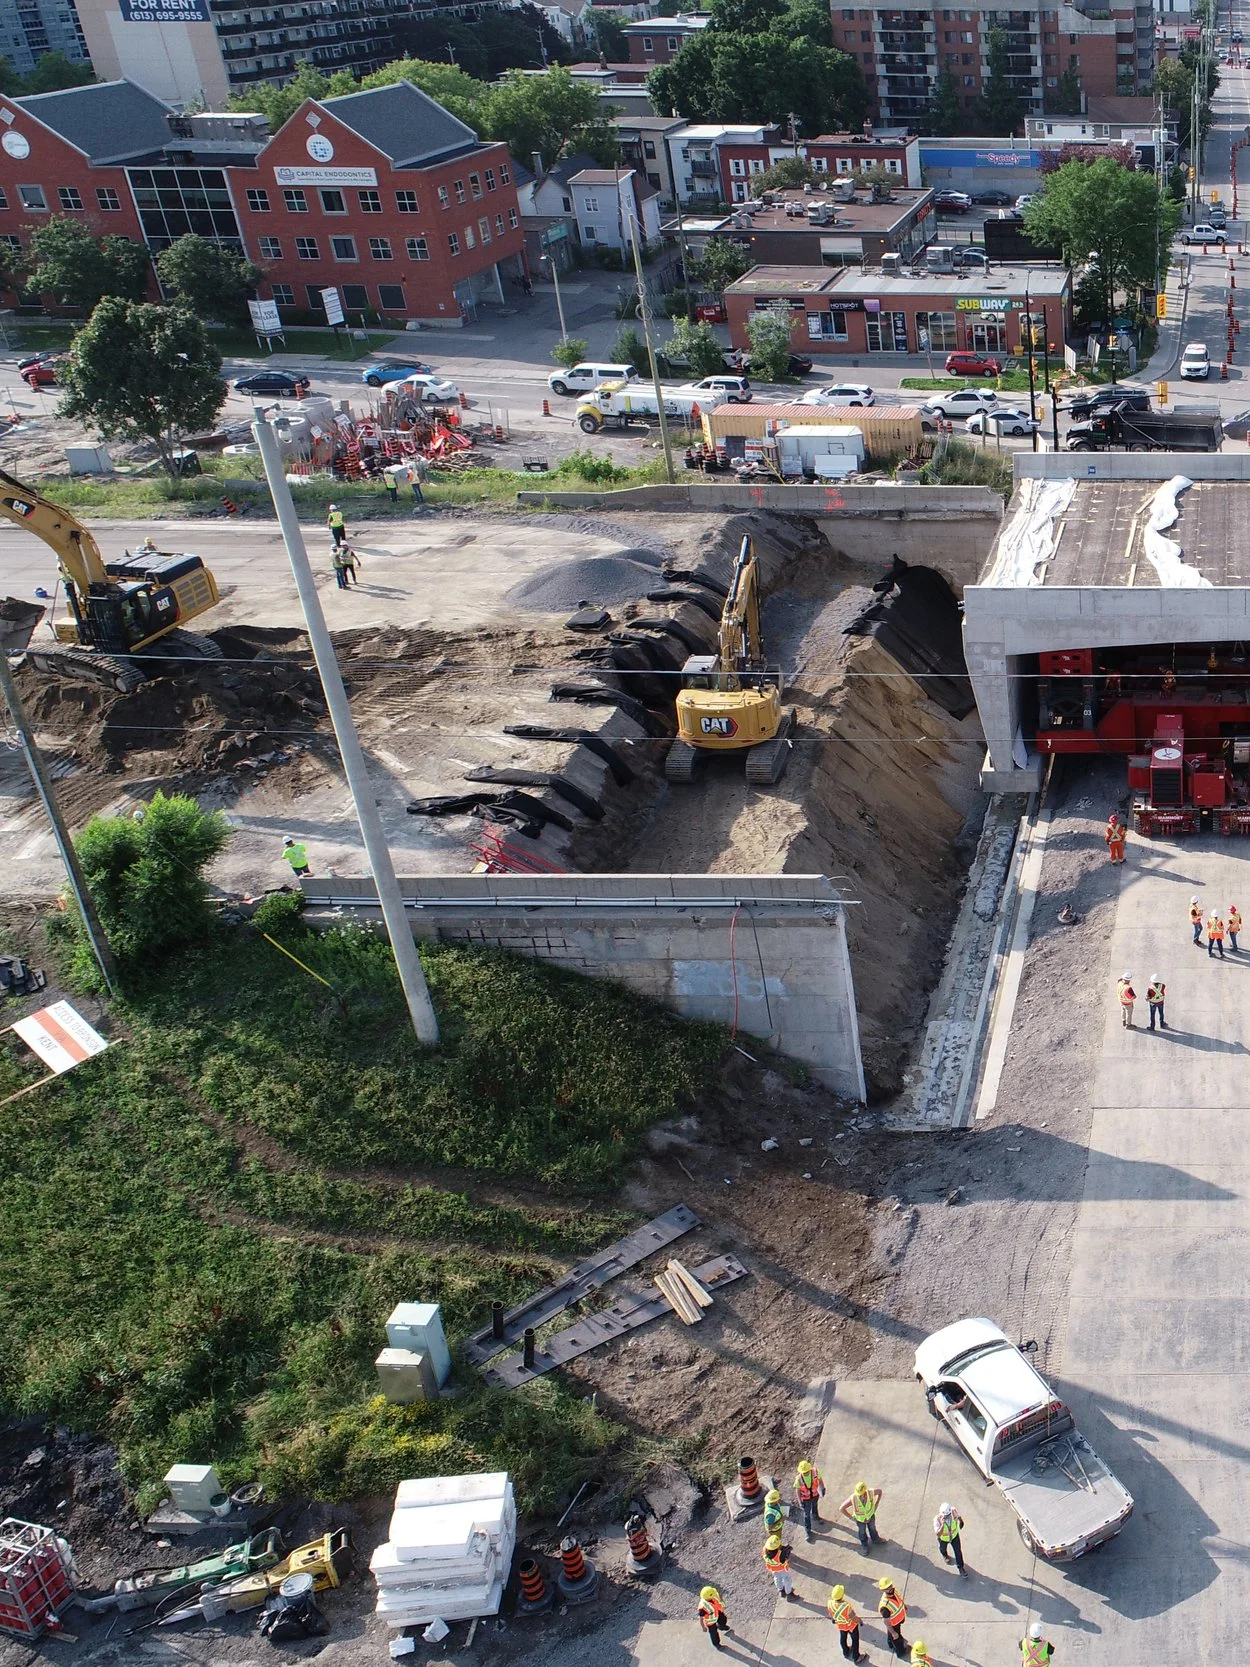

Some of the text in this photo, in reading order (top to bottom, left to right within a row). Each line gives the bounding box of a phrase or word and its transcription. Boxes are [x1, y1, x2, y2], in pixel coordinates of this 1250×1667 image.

[130, 0, 197, 9] FOR RENT
[130, 11, 203, 21] (613) 695-9555
[988, 153, 1019, 164] Speedy
[956, 299, 1007, 310] SUBWAY
[12, 500, 28, 515] CAT
[156, 596, 171, 611] CAT
[701, 717, 728, 733] CAT
[39, 1034, 58, 1052] KENT
